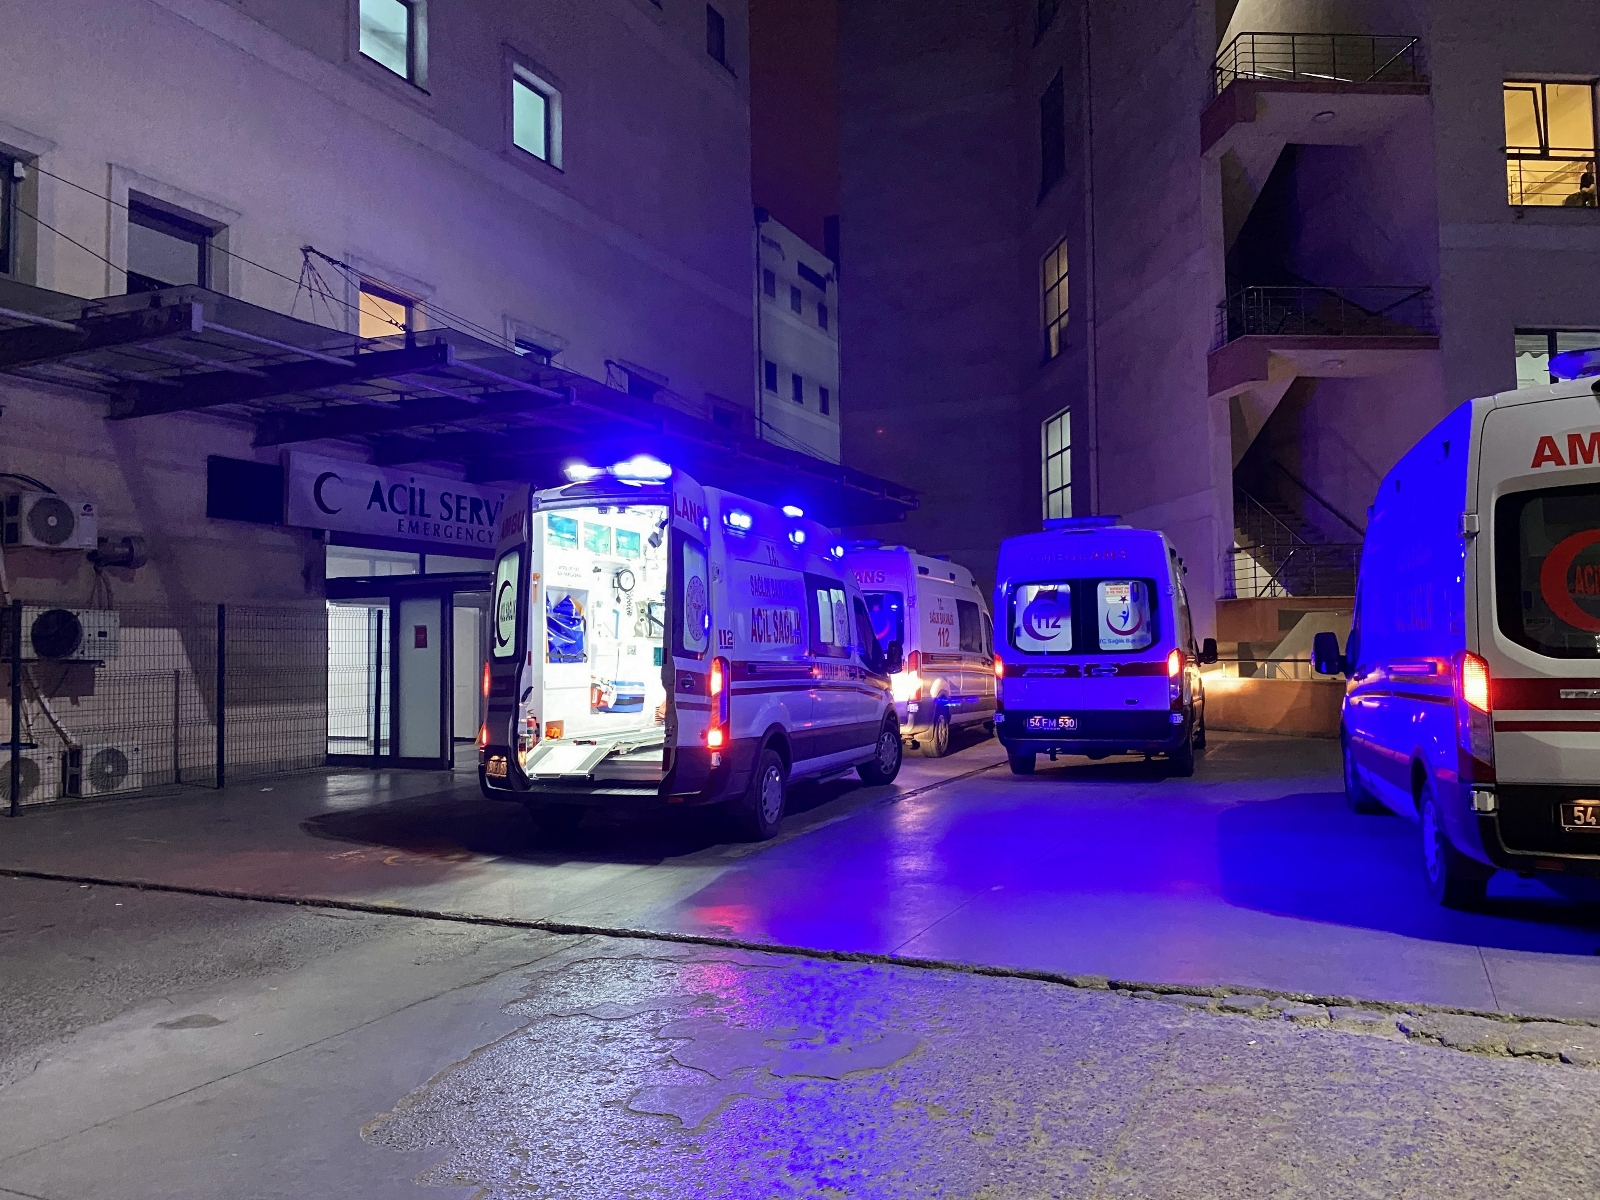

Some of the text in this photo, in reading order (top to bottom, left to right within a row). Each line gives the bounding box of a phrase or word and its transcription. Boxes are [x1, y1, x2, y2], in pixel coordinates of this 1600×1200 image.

[1531, 431, 1600, 468] AM
[367, 477, 431, 518] ACİL
[398, 518, 494, 543] EMERGENCY
[1034, 611, 1061, 629] 112
[718, 629, 733, 645] 112
[938, 627, 950, 647] 112
[1029, 718, 1040, 727] 54
[1573, 806, 1597, 825] 54
